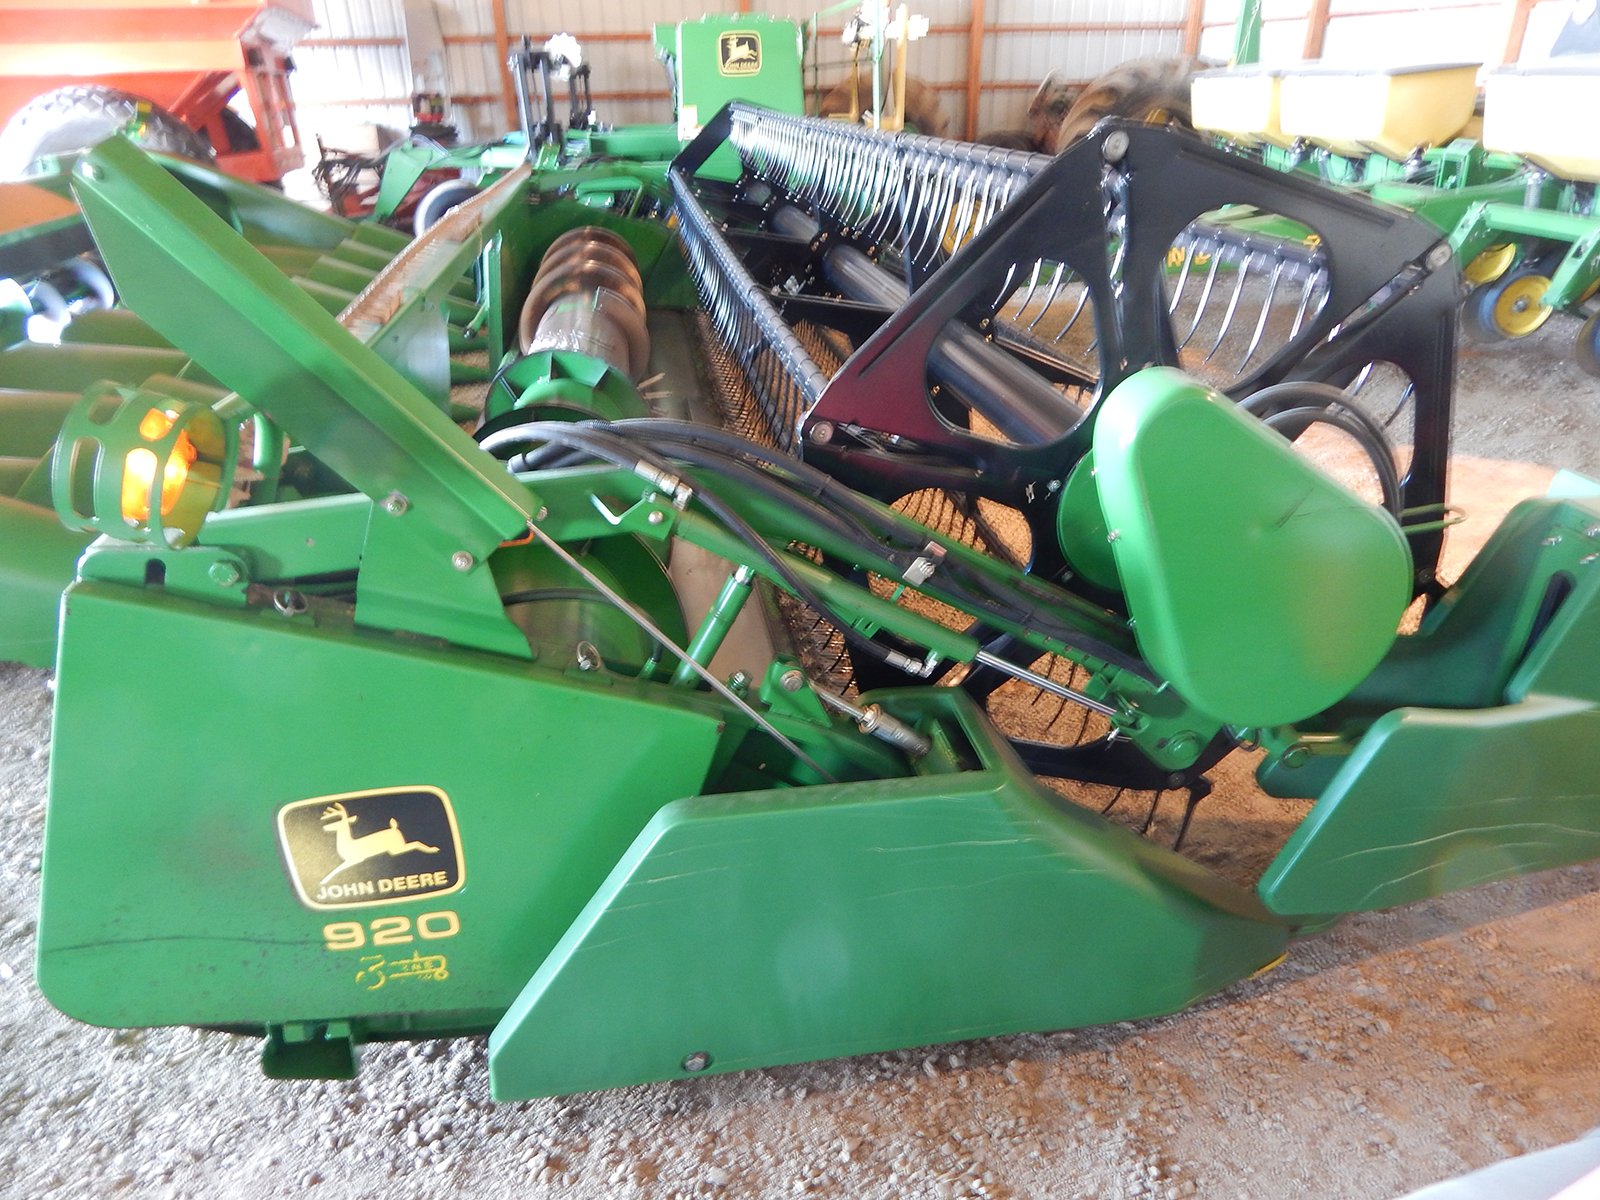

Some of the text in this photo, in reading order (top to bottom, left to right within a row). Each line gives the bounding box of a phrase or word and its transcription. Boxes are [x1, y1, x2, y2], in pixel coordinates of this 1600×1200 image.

[317, 870, 449, 901] JOHN DEERE
[322, 909, 461, 951] 920
